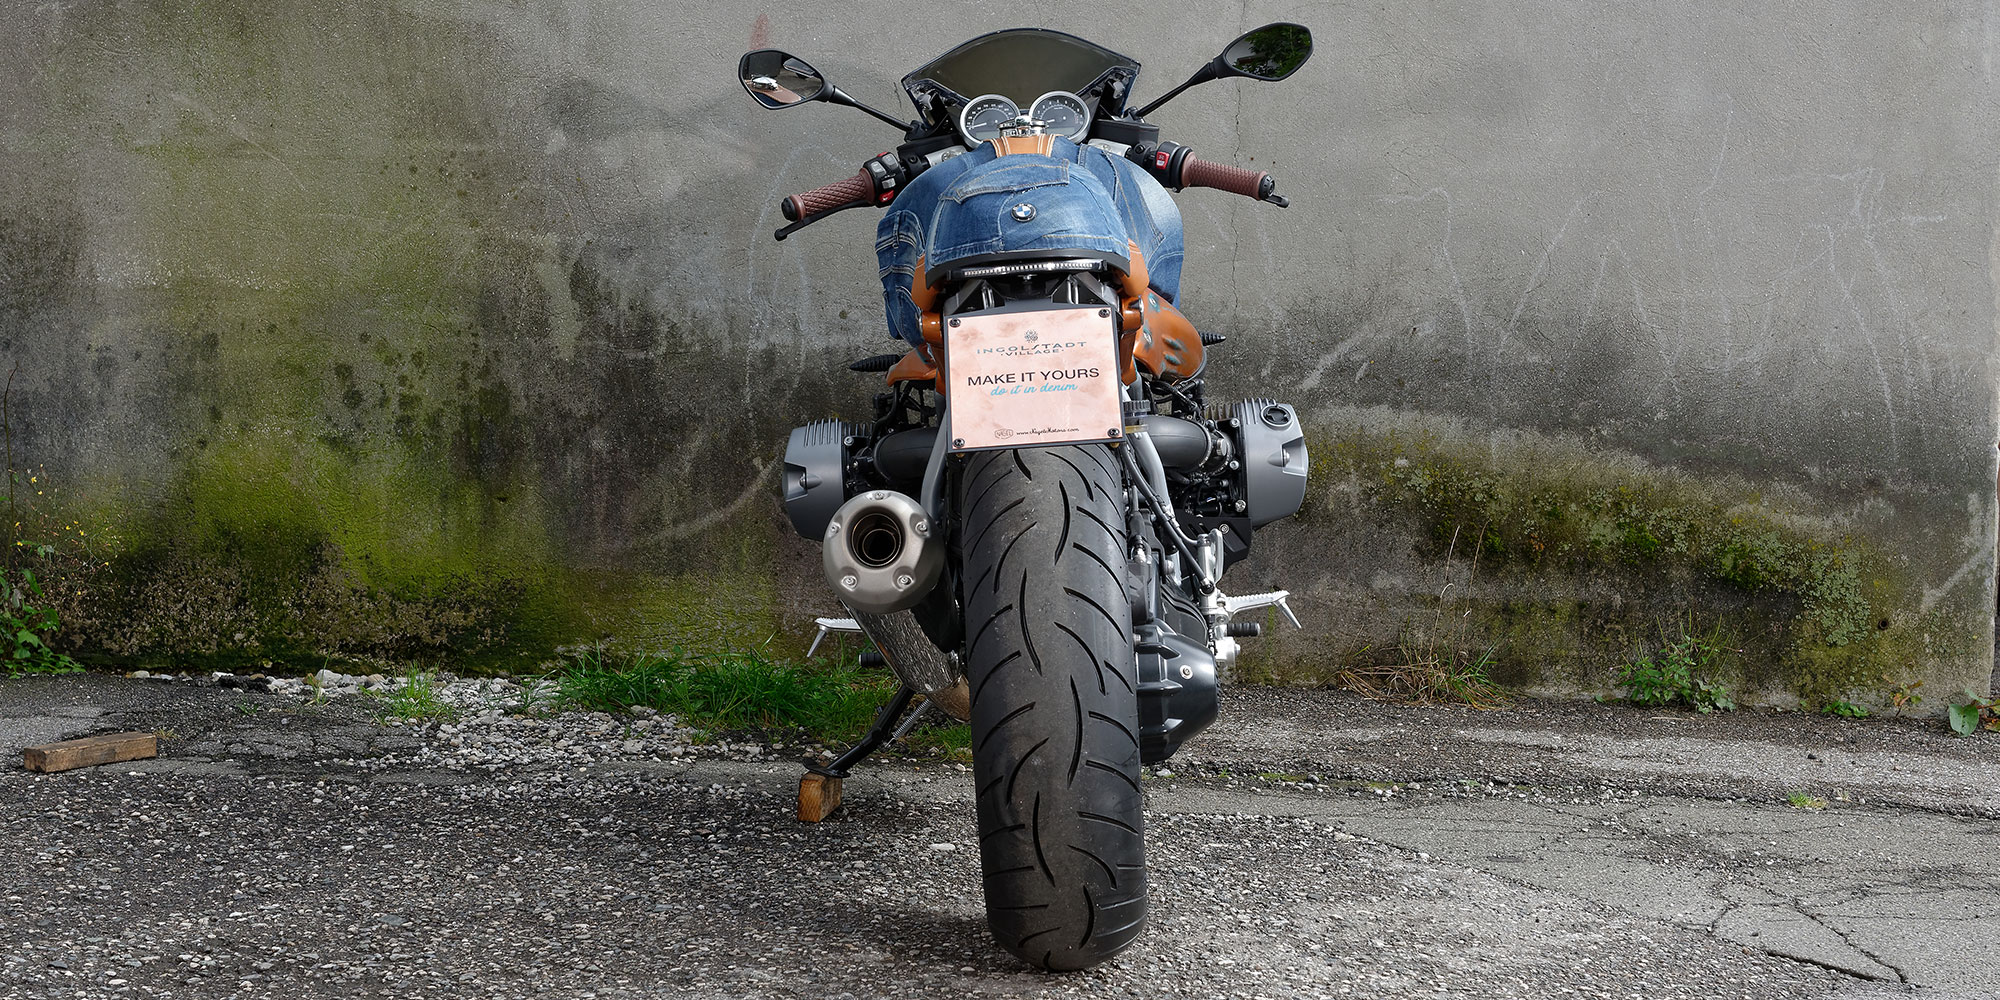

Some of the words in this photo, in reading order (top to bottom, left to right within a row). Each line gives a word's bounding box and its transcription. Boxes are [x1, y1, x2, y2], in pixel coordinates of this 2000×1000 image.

[977, 341, 1087, 354] INGOLSTADT
[967, 373, 1016, 386] MAKE
[1021, 372, 1036, 382] IT
[1040, 367, 1100, 380] YOURS
[990, 385, 1008, 396] do
[1010, 384, 1022, 395] it
[1024, 385, 1038, 394] in
[1040, 382, 1079, 393] denim
